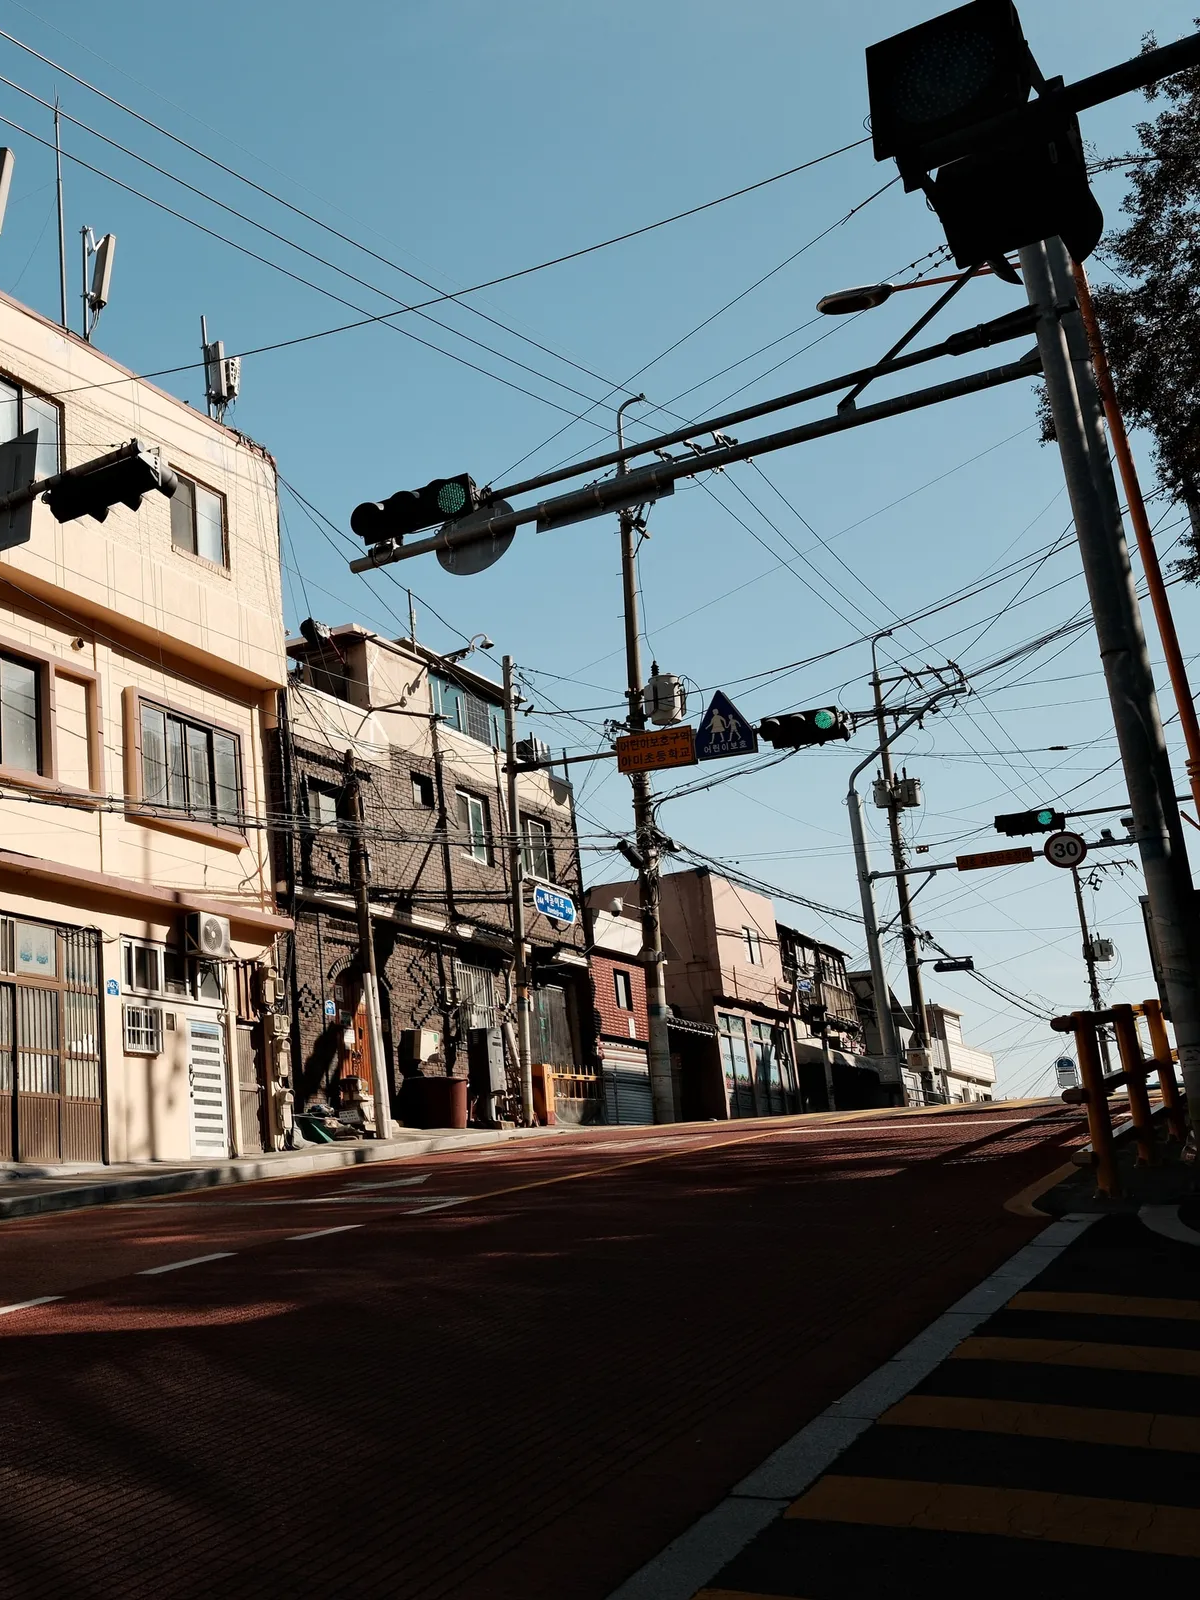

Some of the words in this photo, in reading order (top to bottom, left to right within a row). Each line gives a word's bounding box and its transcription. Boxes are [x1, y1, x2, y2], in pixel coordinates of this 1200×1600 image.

[620, 731, 690, 752] 어린이보호구역
[703, 740, 748, 754] 어린이보호
[621, 747, 690, 766] 아미초등학교
[1054, 841, 1078, 858] 30
